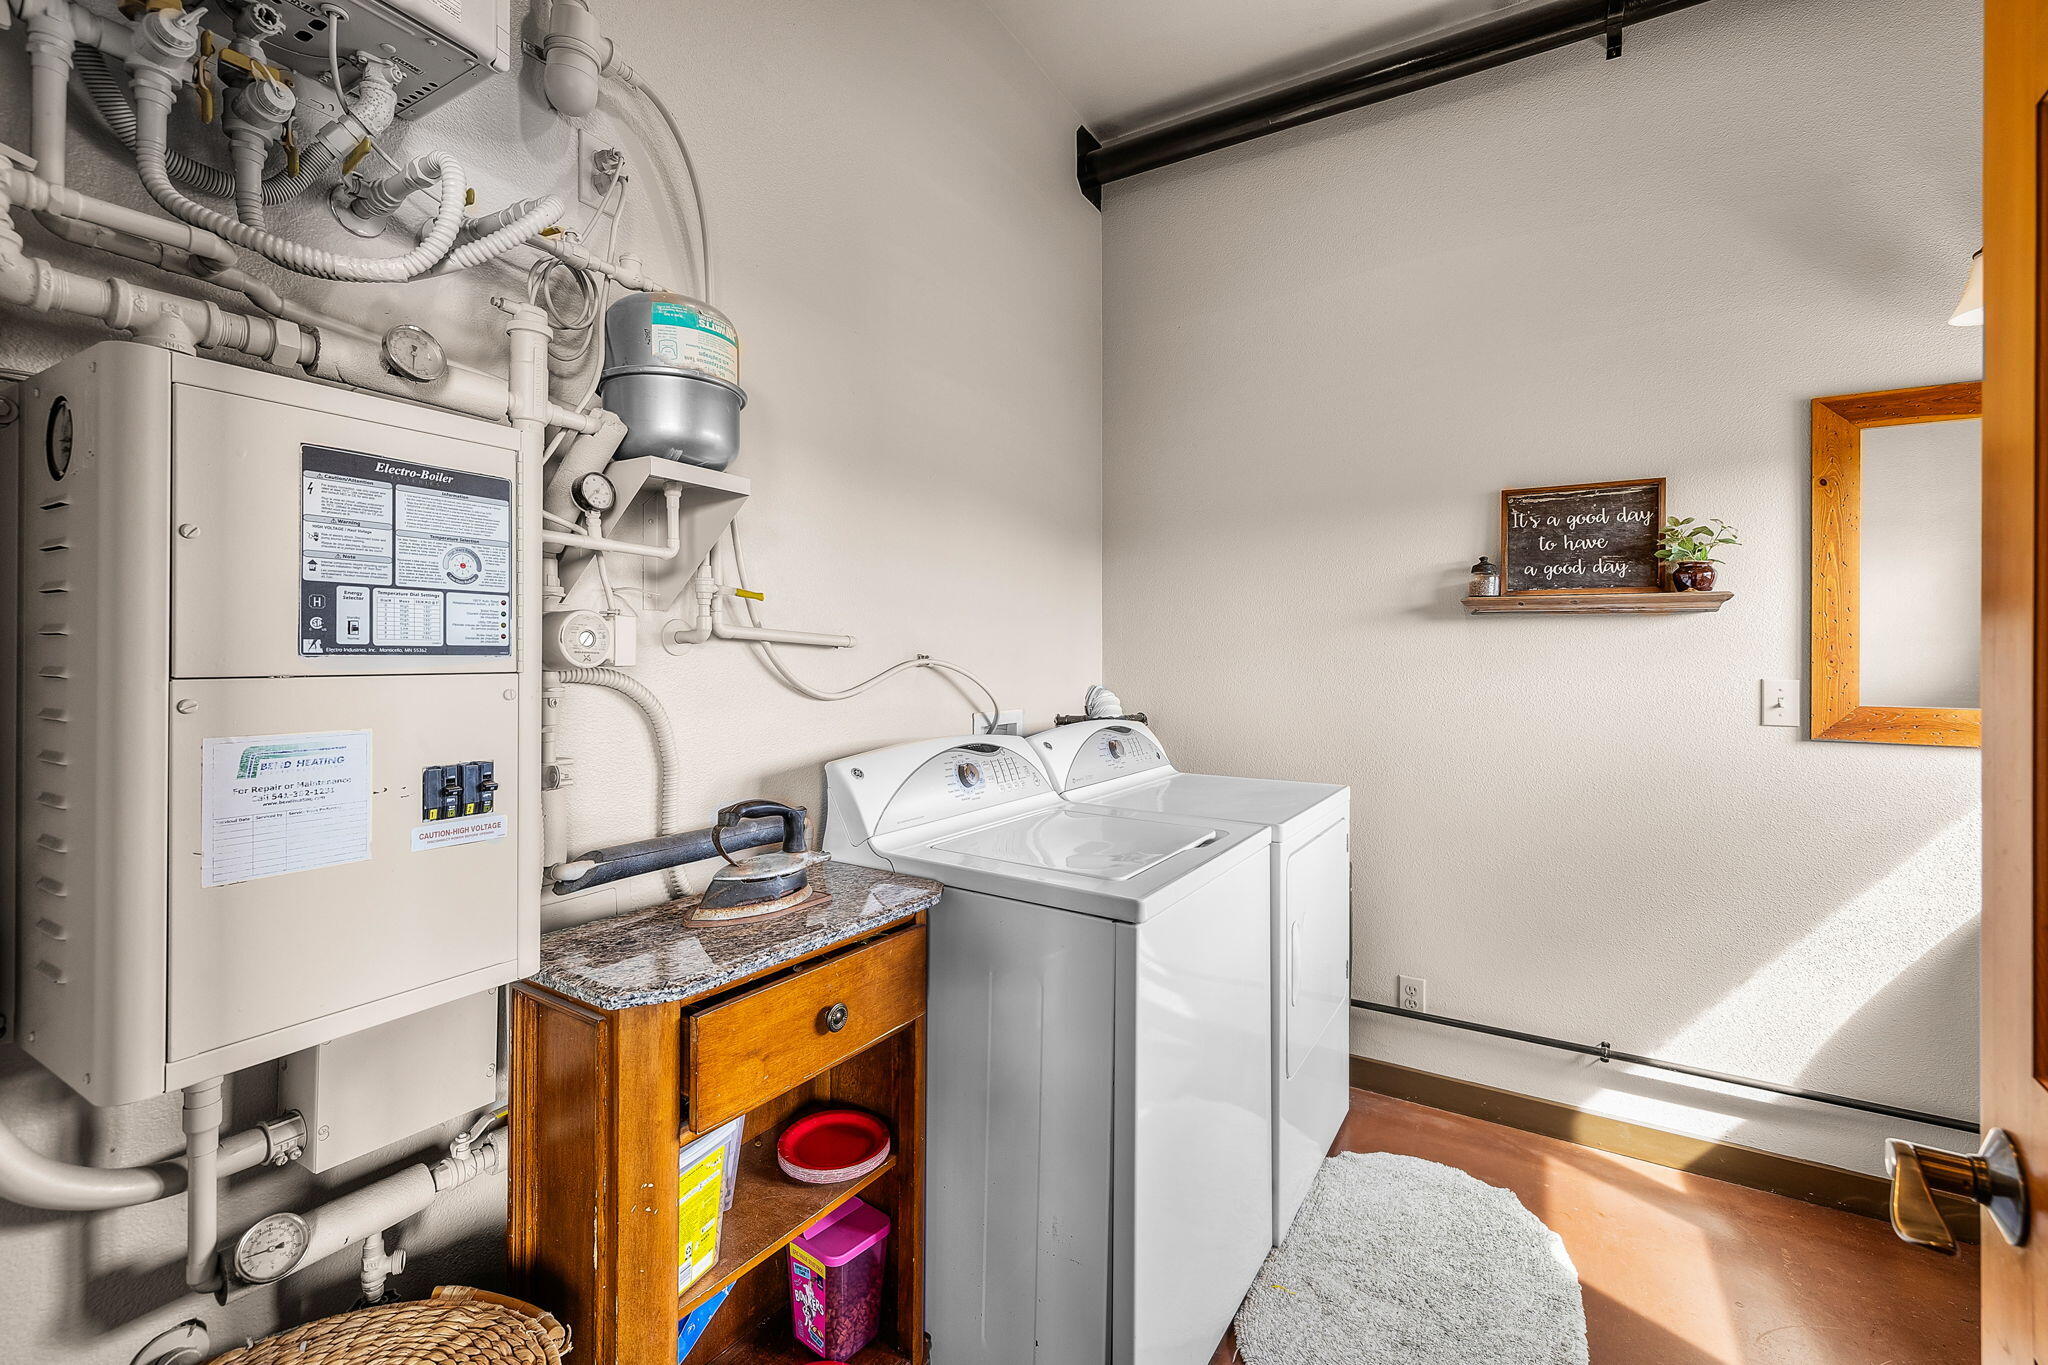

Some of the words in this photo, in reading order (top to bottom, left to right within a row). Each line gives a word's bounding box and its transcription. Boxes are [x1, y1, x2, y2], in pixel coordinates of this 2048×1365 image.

[324, 474, 374, 486] Caution/Attention
[374, 462, 454, 484] Electro-Boiler
[338, 519, 360, 527] Warning
[1512, 508, 1541, 529] It's
[1546, 517, 1560, 526] a
[1567, 508, 1610, 531] good
[1616, 506, 1654, 527] day
[1538, 536, 1558, 552] to
[1563, 535, 1609, 552] have
[1524, 565, 1538, 577] a
[1543, 558, 1587, 580] good
[1592, 557, 1632, 579] day.
[260, 760, 292, 771] BEND
[296, 756, 345, 767] HEATING
[232, 787, 249, 796] For
[251, 783, 282, 795] Repair
[296, 777, 352, 789] Maintenance
[252, 794, 270, 802] Call
[418, 826, 470, 840] CAUTION-HIGH
[470, 822, 502, 832] VOLTAGE
